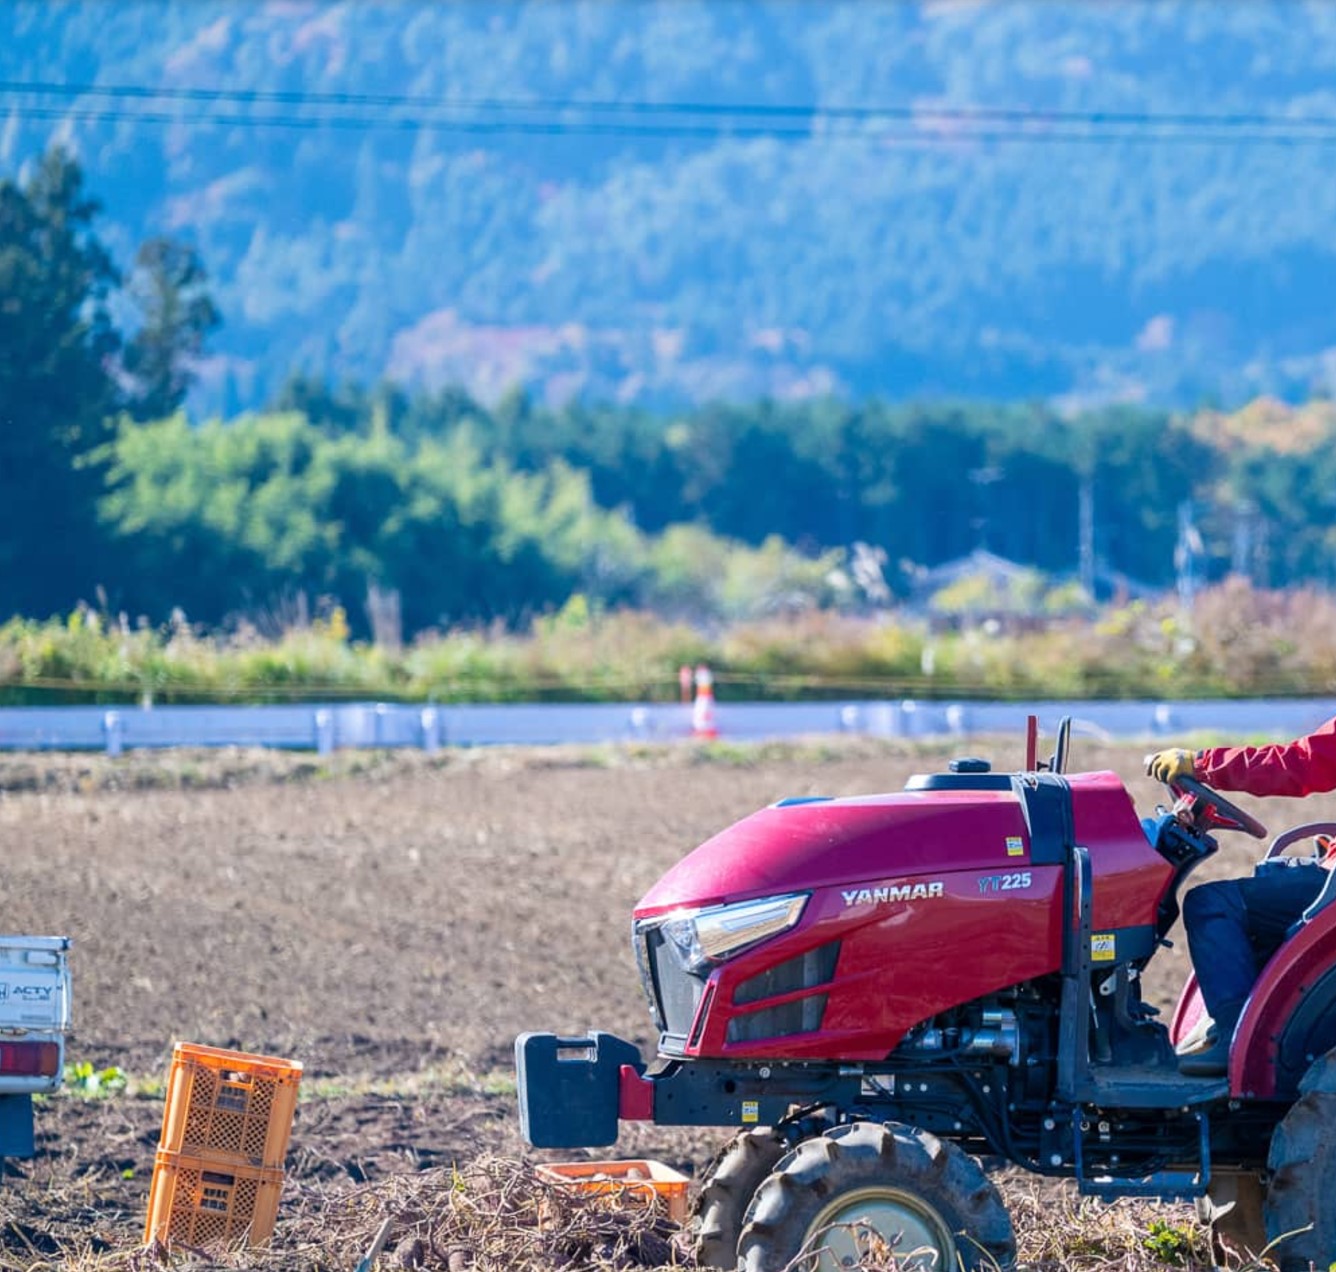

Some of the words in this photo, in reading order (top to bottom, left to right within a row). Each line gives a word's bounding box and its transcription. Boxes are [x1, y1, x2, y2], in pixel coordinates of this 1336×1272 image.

[977, 872, 1032, 893] YT225
[841, 881, 944, 906] YANMAR
[12, 985, 52, 995] ACTY
